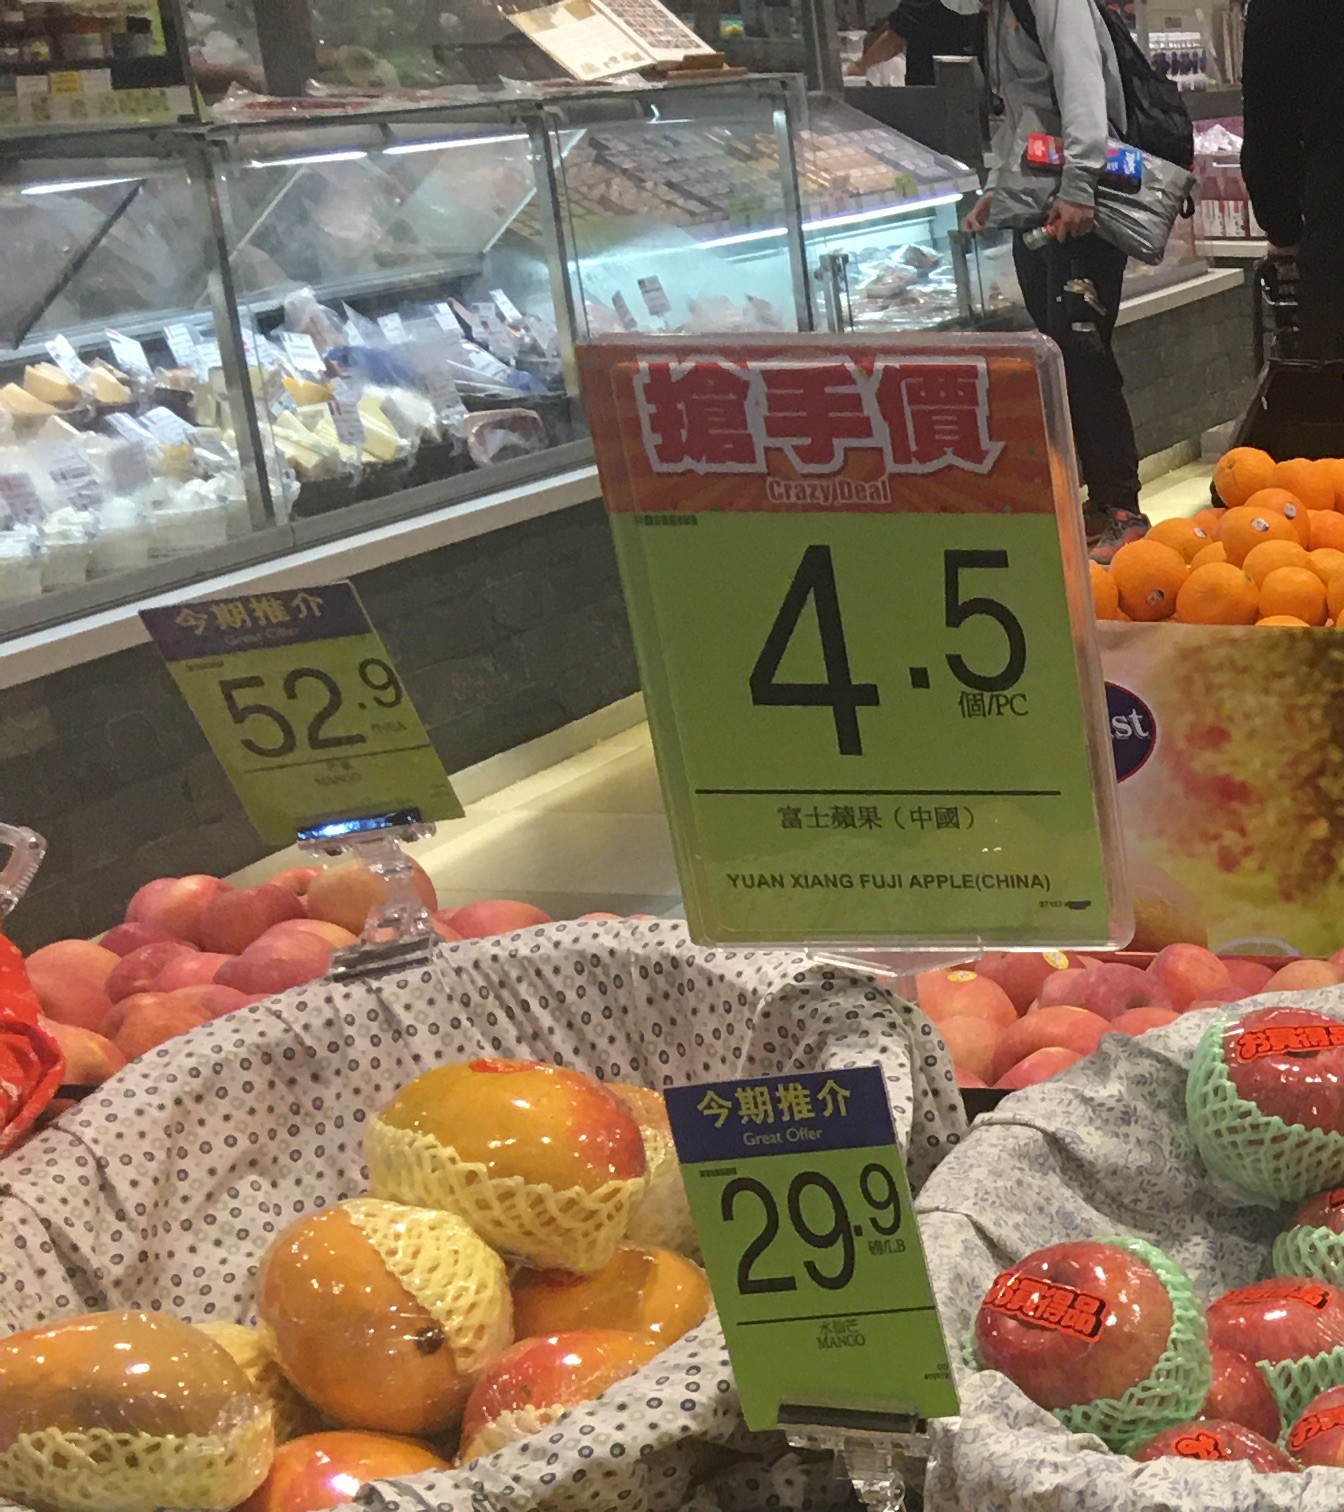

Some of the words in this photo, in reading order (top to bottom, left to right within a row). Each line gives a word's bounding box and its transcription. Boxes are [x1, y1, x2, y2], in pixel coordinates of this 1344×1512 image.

[634, 355, 1006, 474] 搶手價
[767, 477, 832, 505] Crazy
[835, 476, 892, 503] Deal
[174, 590, 324, 635] 今期推介
[749, 544, 1027, 756] 4.5
[218, 657, 404, 758] 52.9
[958, 690, 1029, 719] 個/PC
[777, 804, 977, 831] 富士蘋果（中國）
[727, 872, 785, 891] YUAN
[791, 872, 855, 891] XIANG
[859, 872, 903, 891] FUJI
[909, 872, 1052, 893] APPLE(CHINA)
[697, 1079, 850, 1128] 今期推介
[743, 1130, 782, 1147] Great
[786, 1127, 823, 1143] Offer
[721, 1163, 901, 1295] 29.9
[817, 1333, 866, 1349] MANGO
